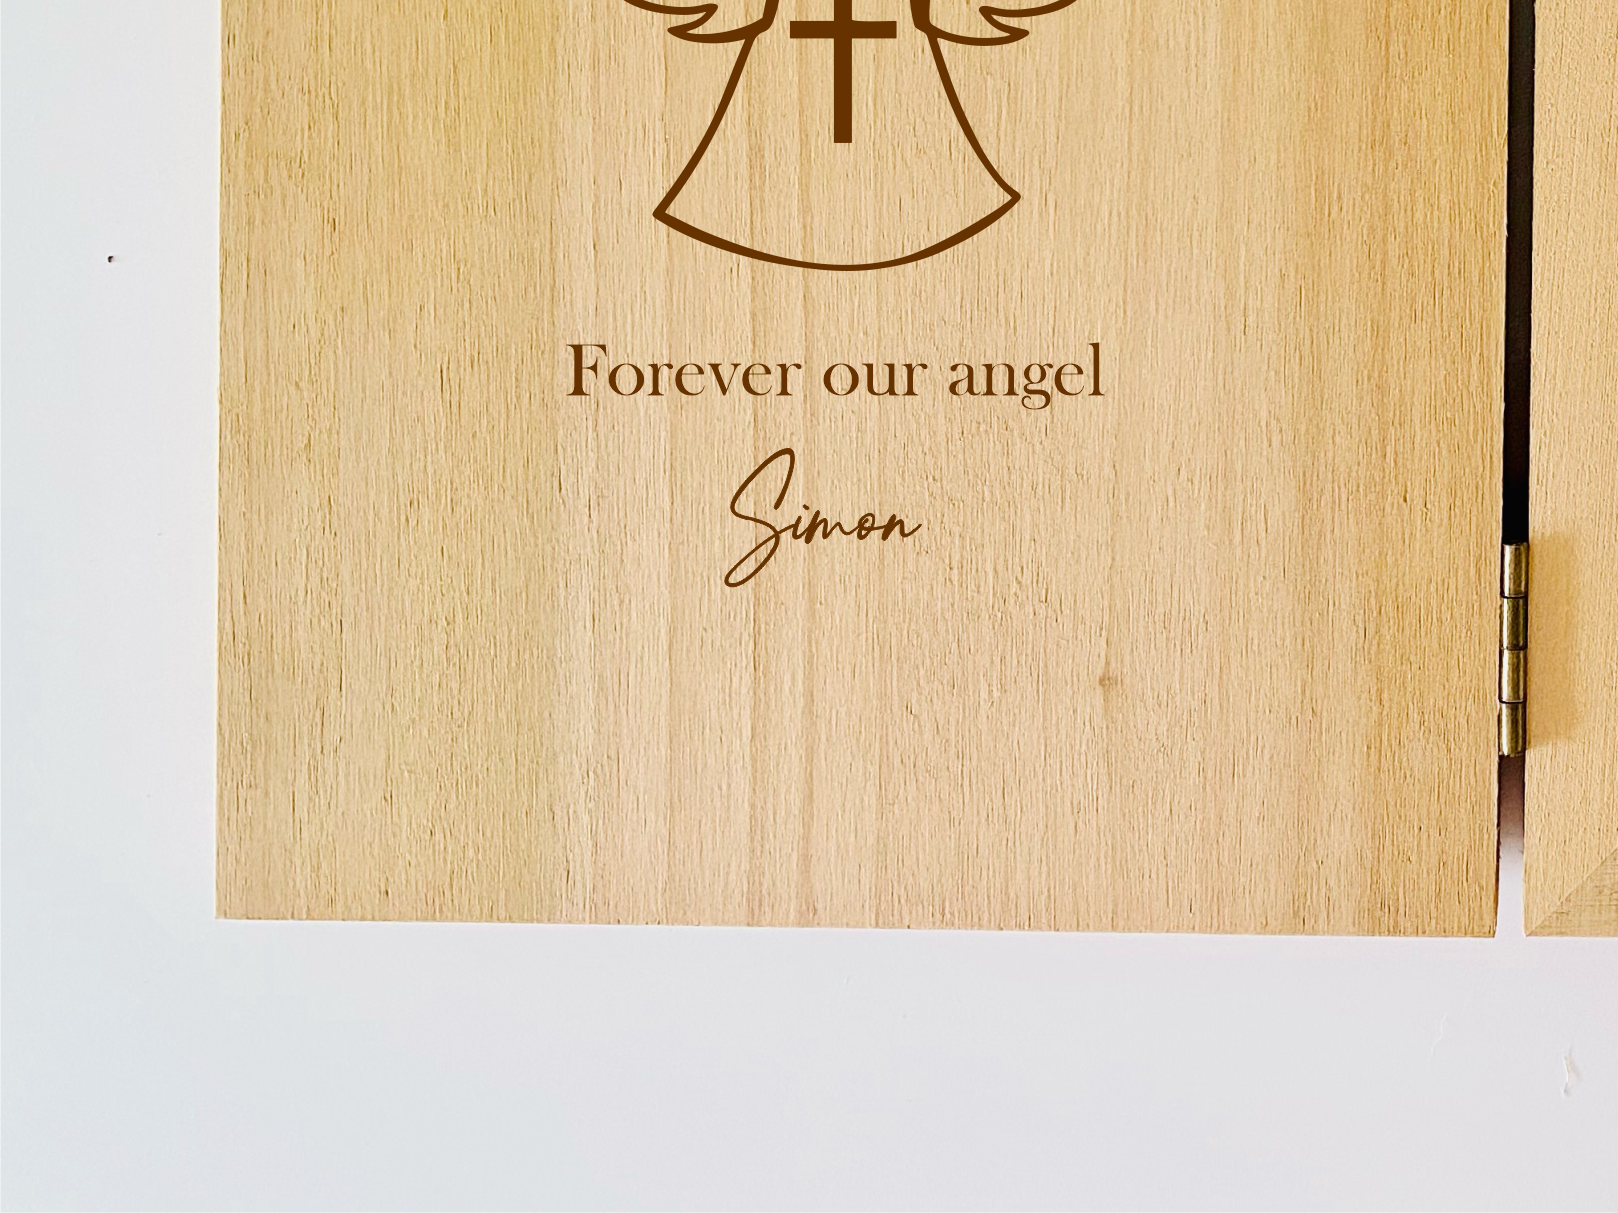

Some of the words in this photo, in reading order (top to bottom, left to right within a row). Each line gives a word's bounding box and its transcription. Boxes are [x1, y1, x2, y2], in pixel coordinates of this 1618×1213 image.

[567, 343, 802, 397] Forever
[823, 359, 928, 397] our
[948, 342, 1105, 410] angel
[724, 447, 922, 588] Simon
